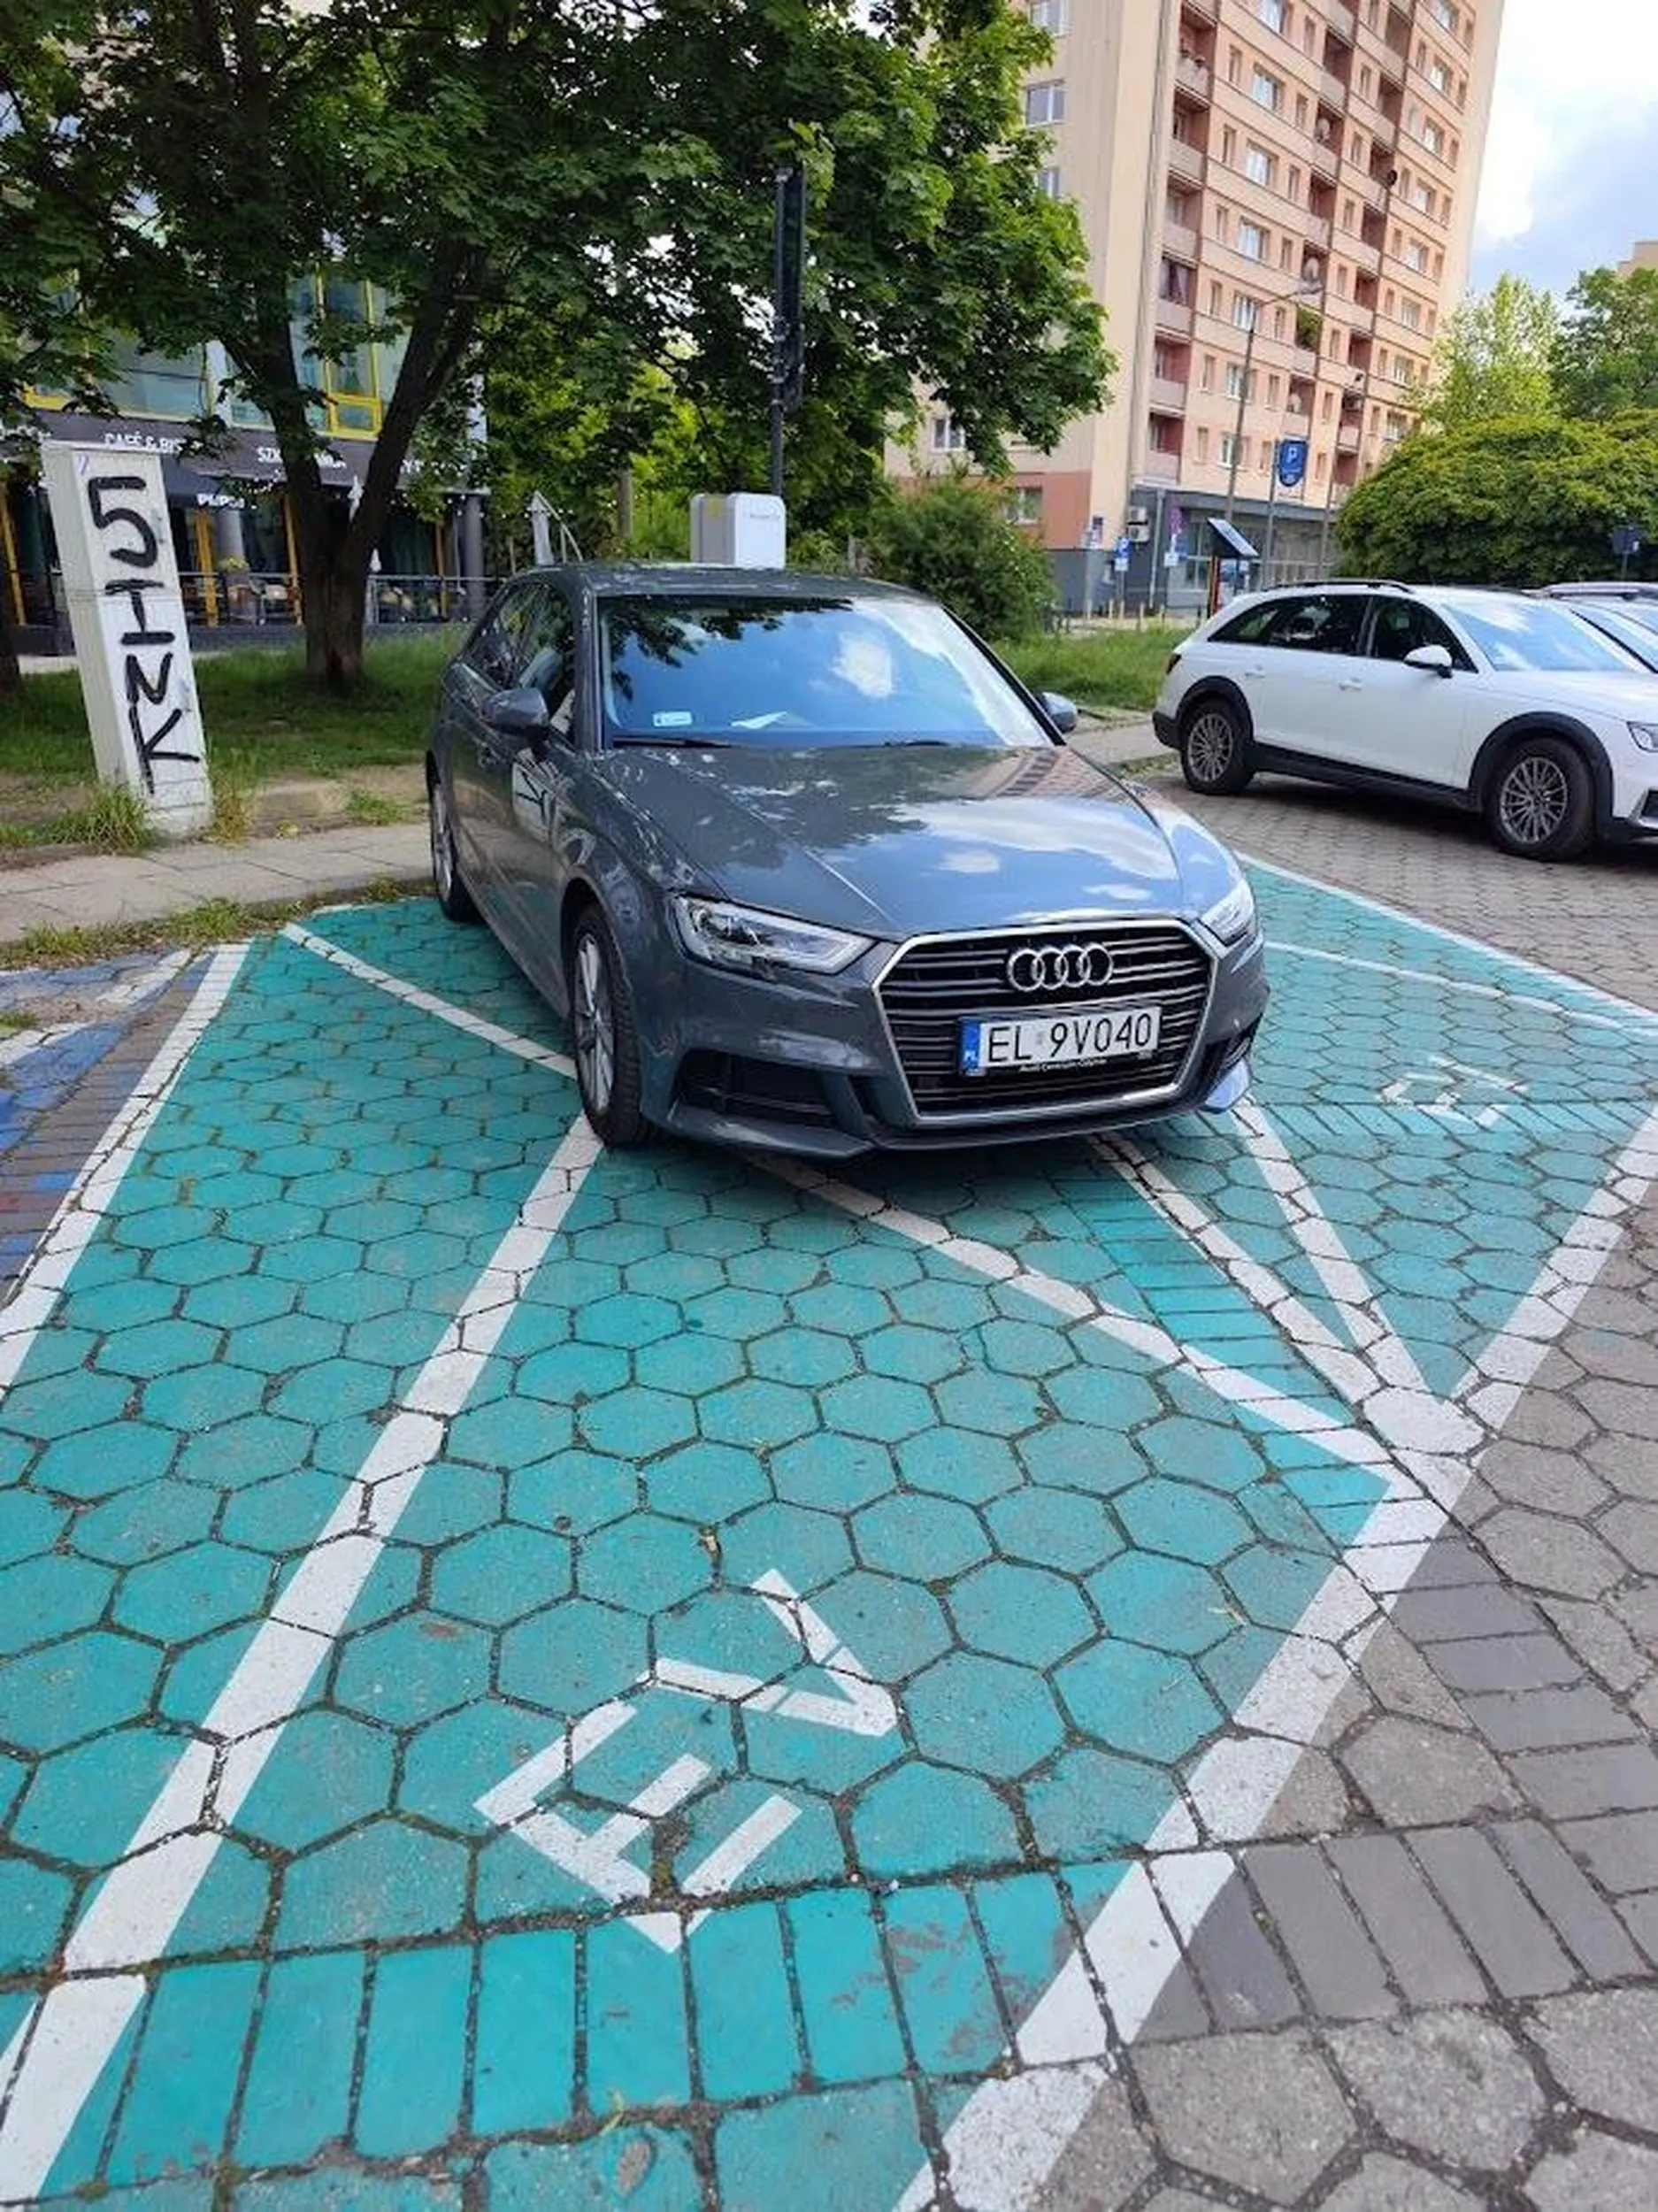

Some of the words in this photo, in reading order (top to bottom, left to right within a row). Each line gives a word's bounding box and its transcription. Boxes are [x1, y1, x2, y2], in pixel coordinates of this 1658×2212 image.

[1286, 447, 1298, 463] P
[988, 1025, 1032, 1063] EL
[1049, 1012, 1153, 1058] 9V040
[472, 1567, 899, 1954] EV
